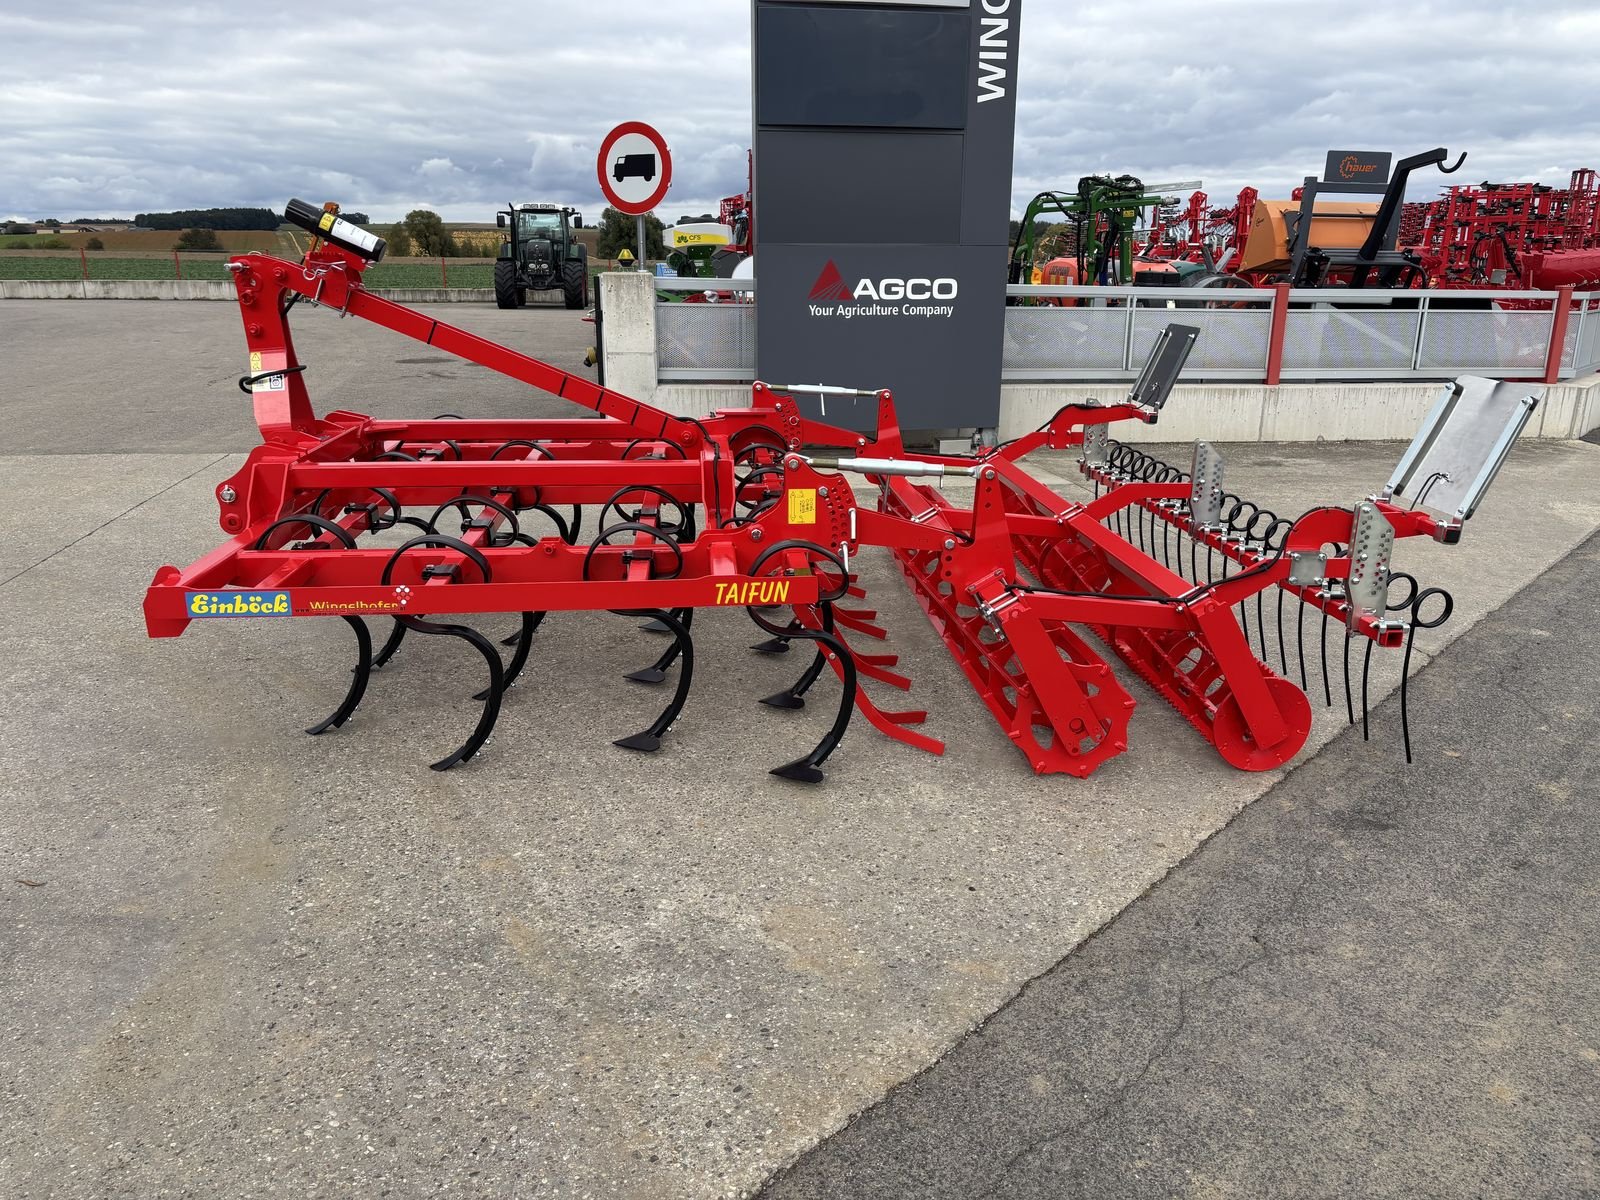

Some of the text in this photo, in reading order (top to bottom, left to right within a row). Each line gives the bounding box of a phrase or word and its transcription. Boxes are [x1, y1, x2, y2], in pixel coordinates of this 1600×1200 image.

[1345, 161, 1377, 173] hauer
[853, 278, 958, 300] AGCO
[809, 304, 954, 318] Your Agriculture Company
[715, 581, 790, 604] TAIFUN
[190, 593, 288, 614] Einböck
